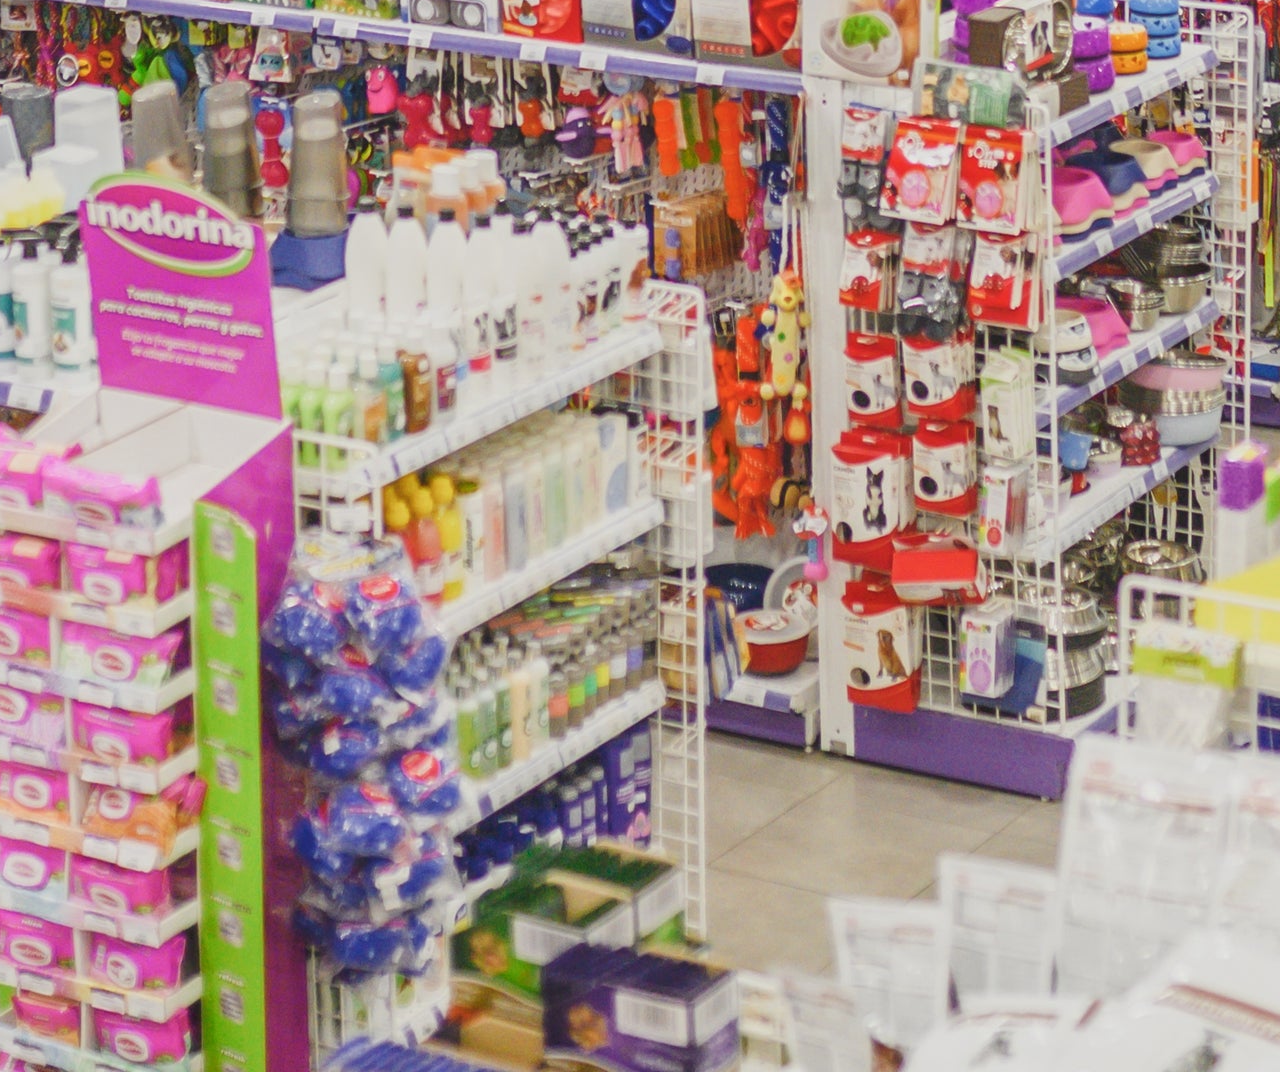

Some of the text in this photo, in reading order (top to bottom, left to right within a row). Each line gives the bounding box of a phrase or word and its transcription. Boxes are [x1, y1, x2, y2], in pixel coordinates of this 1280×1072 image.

[86, 194, 255, 250] inodorina
[99, 299, 126, 314] para
[183, 315, 218, 331] perros
[219, 322, 228, 336] y
